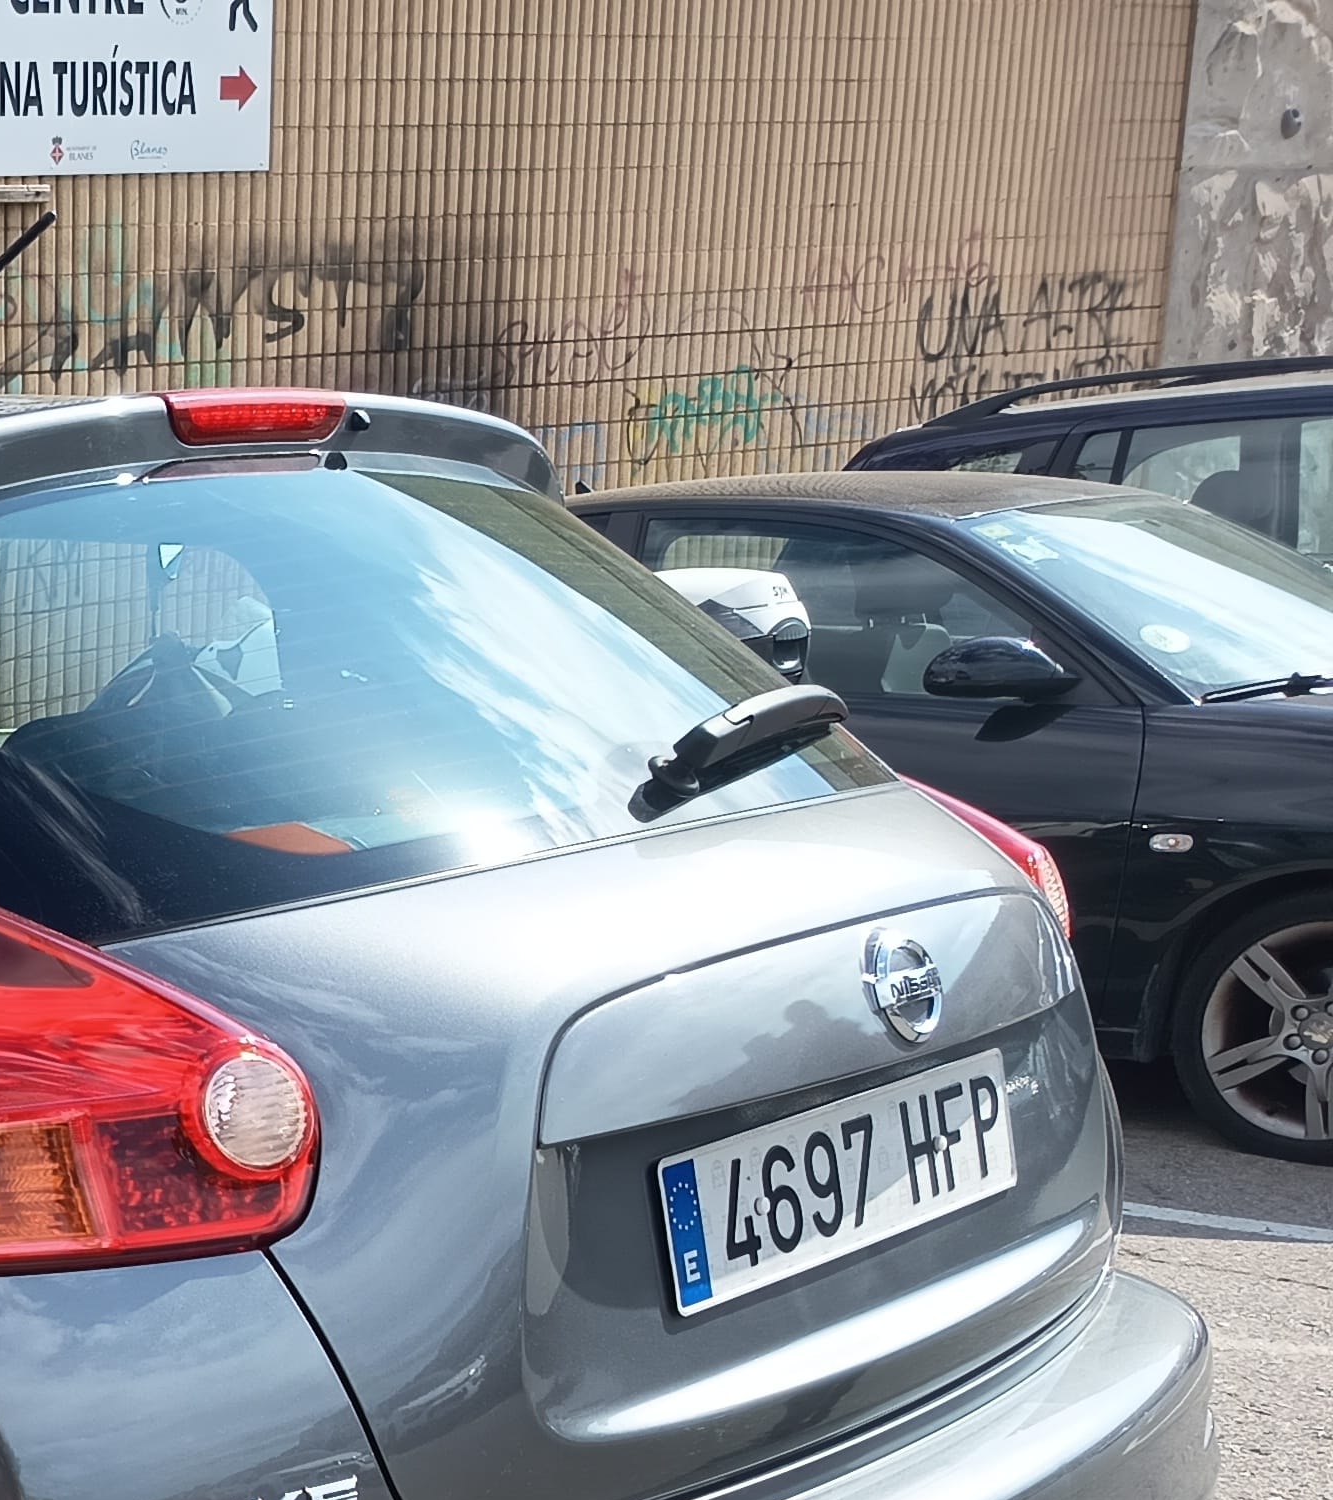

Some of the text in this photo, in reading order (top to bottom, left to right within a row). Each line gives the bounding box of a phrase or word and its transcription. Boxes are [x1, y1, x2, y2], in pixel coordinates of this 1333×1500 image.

[52, 45, 197, 117] TURÍSTICA
[131, 139, 168, 160] Blanes
[726, 1076, 1000, 1267] 4697 HFP
[683, 1250, 701, 1283] E
